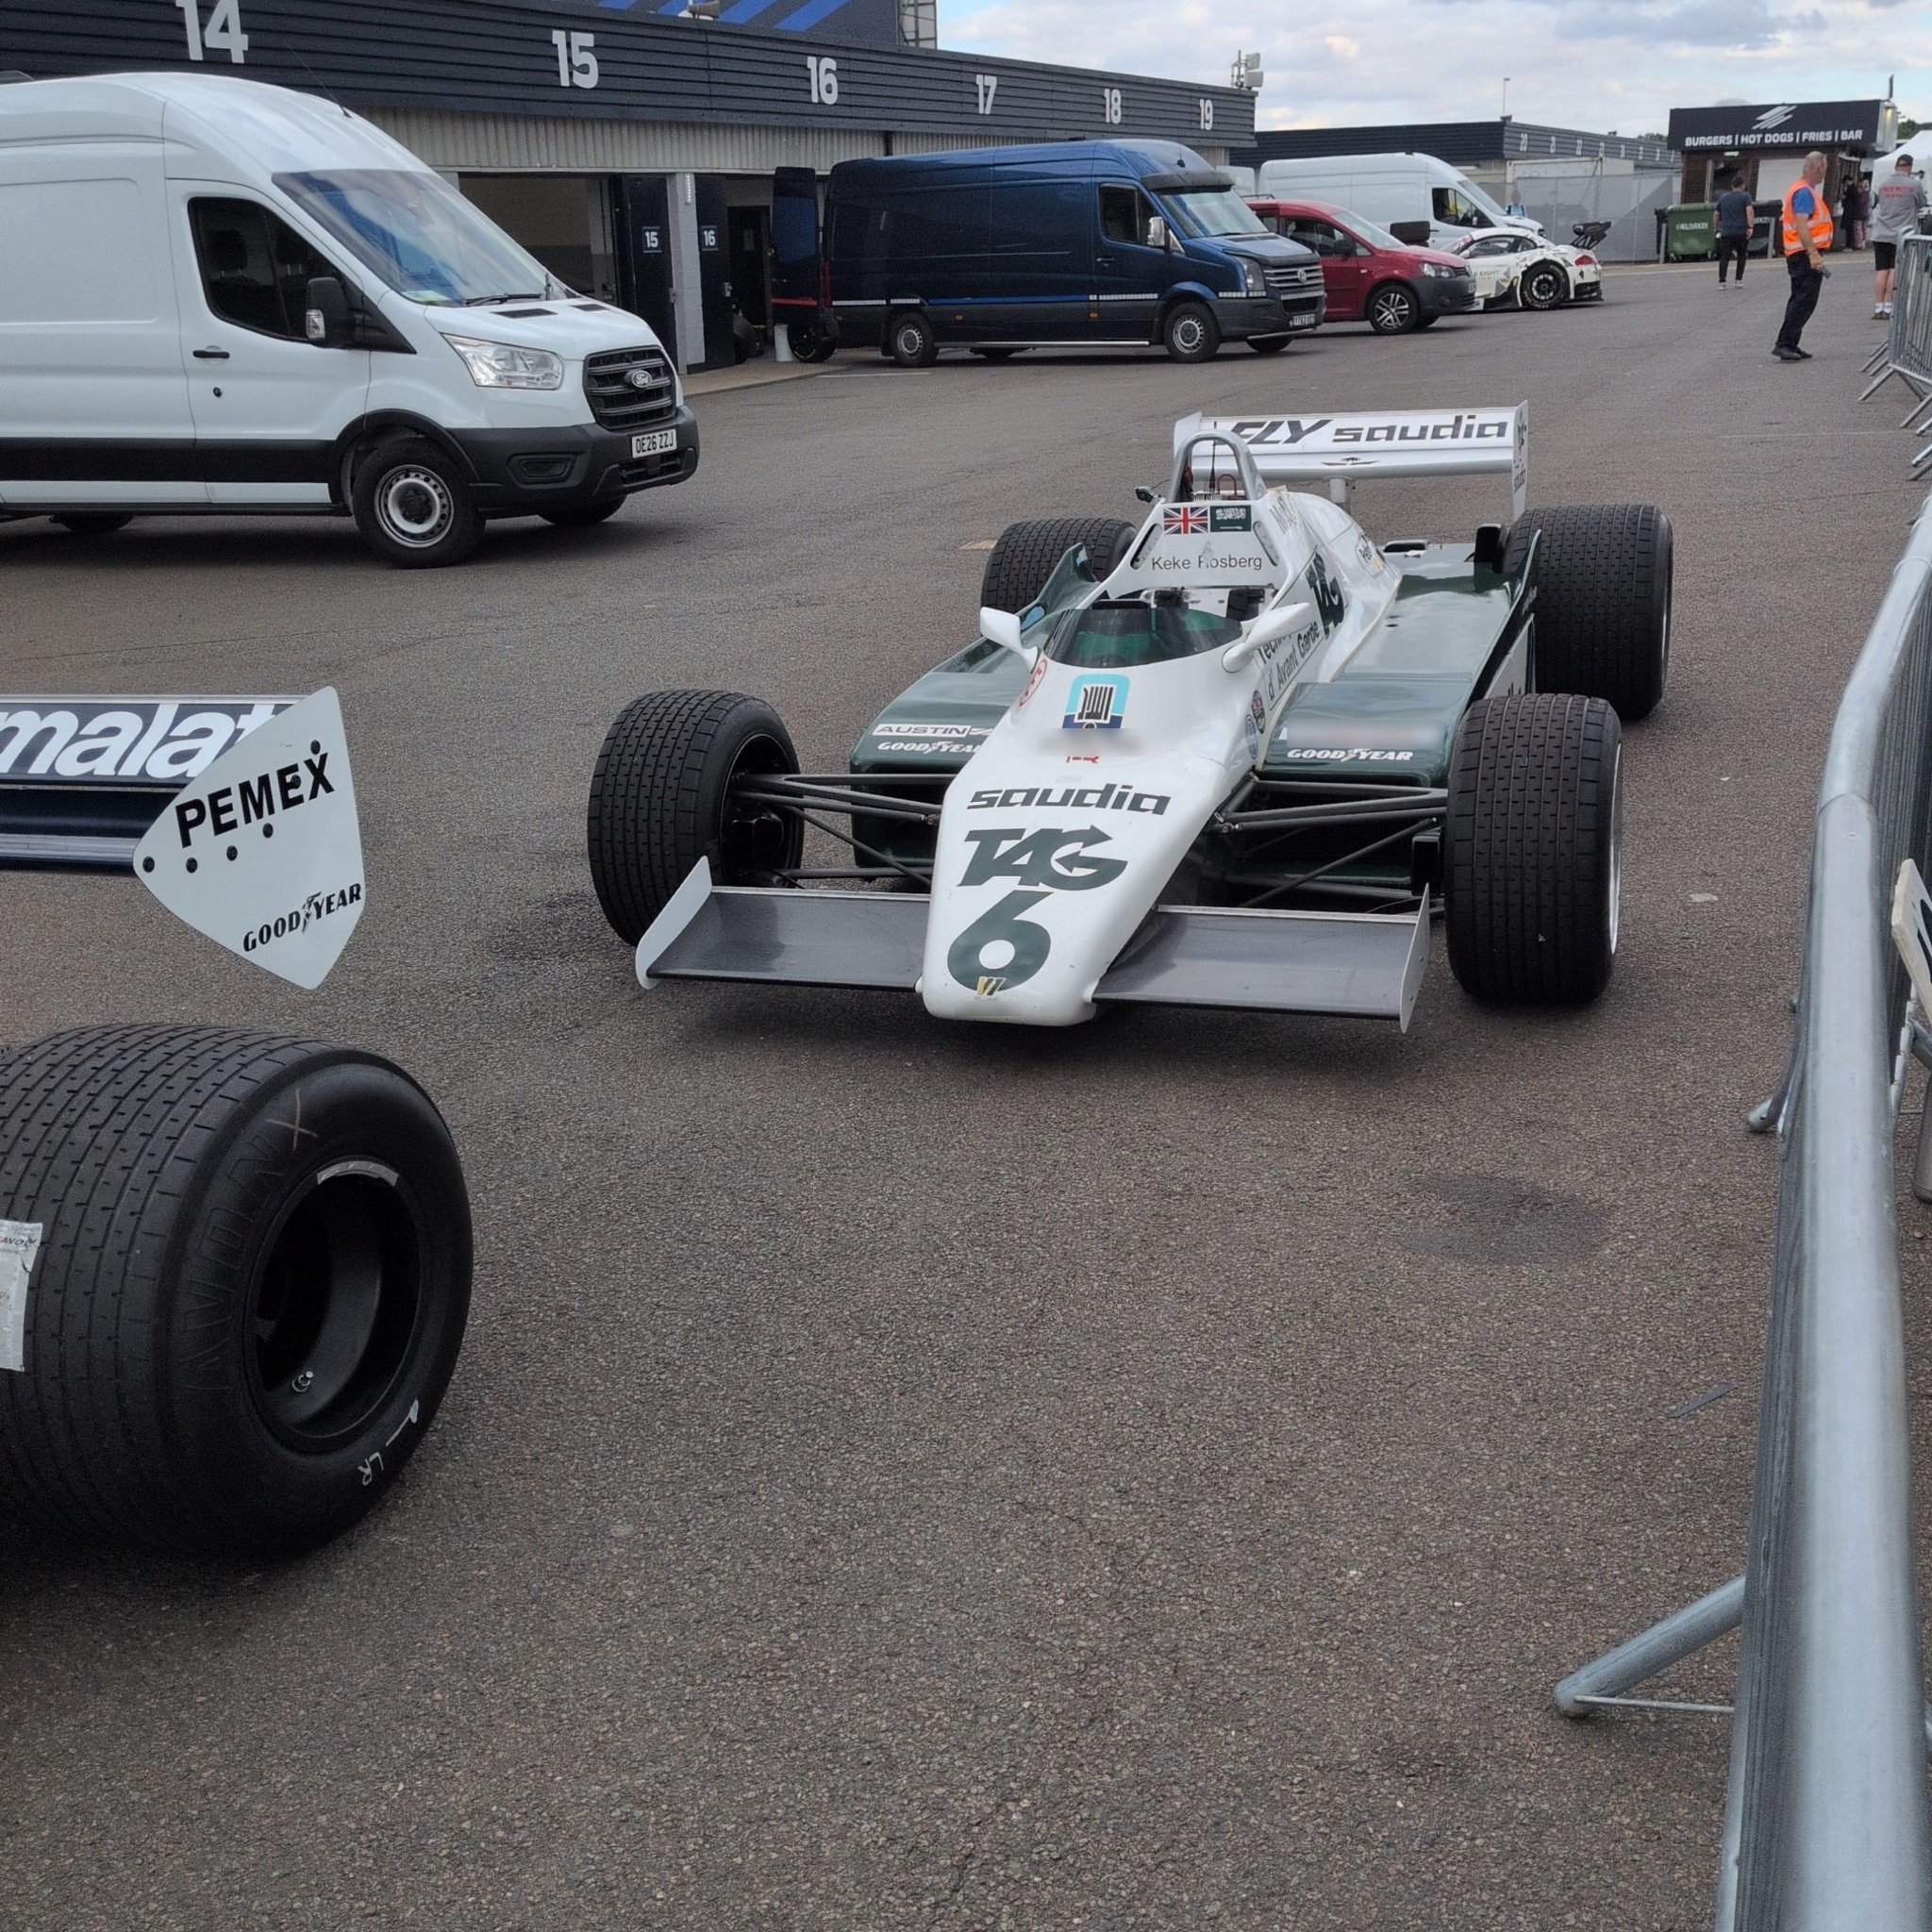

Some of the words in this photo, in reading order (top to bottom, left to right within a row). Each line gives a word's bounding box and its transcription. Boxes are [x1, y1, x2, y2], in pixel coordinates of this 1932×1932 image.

[175, 0, 248, 63] 14
[552, 30, 598, 89] 15
[807, 57, 839, 104] 16
[975, 75, 997, 114] 17
[1104, 89, 1122, 124] 18
[1199, 99, 1213, 130] 19
[1685, 135, 1732, 146] BURGERS
[1740, 134, 1762, 143] HOT
[1764, 132, 1793, 143] DOGS
[1802, 130, 1832, 142] FRIES
[1841, 129, 1862, 141] BAR
[645, 231, 658, 248] 15
[704, 230, 715, 246] 16
[636, 436, 658, 454] OE26
[658, 432, 675, 449] ZZJ
[1332, 414, 1509, 443] saudia
[1152, 558, 1191, 570] Keke
[877, 725, 968, 736] AUSTIN
[1287, 748, 1414, 762] GOODYEAR
[175, 752, 336, 849] PEMEX
[966, 783, 1172, 816] saudia
[957, 824, 1129, 891] TAG
[242, 882, 362, 953] GOODYEAR
[946, 889, 1055, 992] 6
